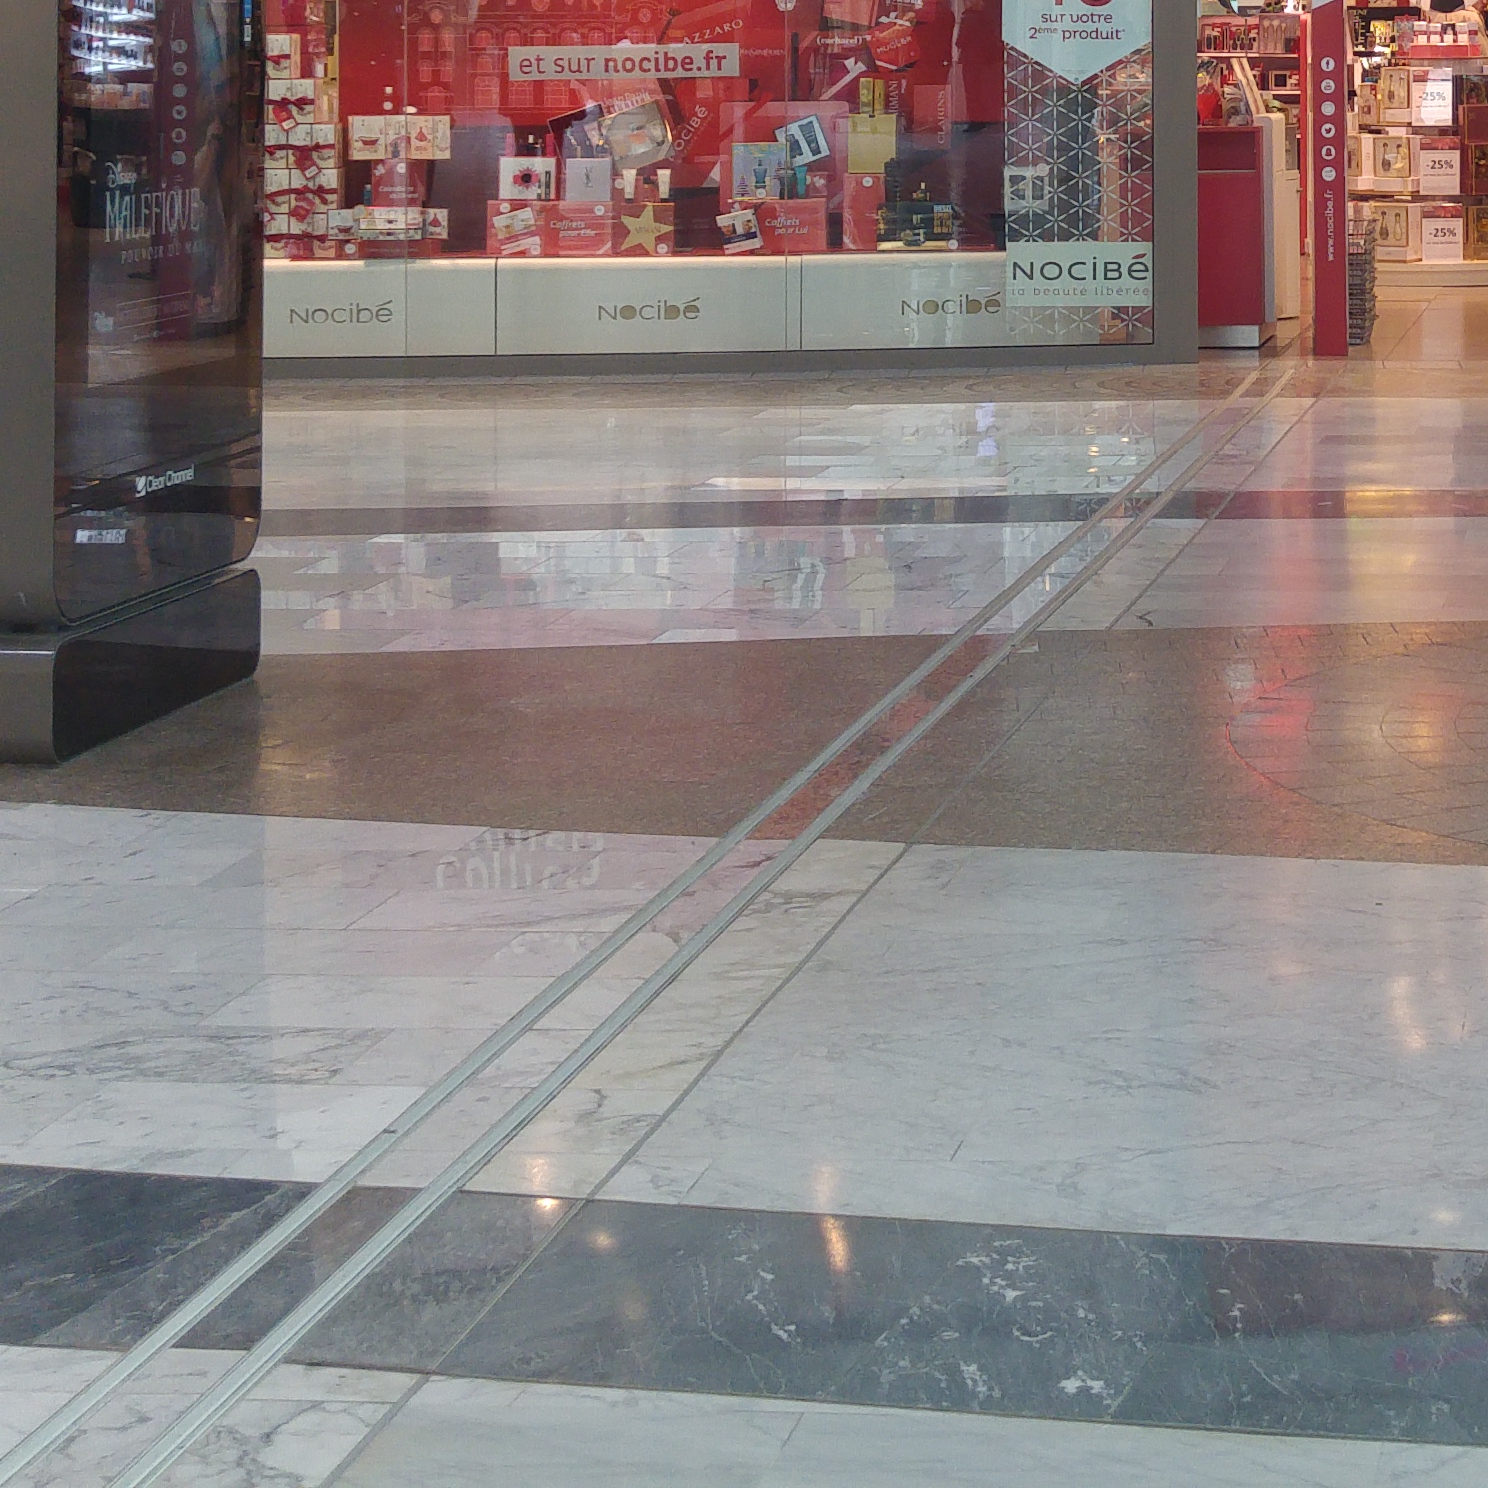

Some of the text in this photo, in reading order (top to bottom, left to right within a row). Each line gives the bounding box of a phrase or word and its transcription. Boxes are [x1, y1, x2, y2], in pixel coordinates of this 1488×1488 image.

[1041, 13, 1066, 23] sur
[682, 19, 743, 44] AZZARO
[876, 35, 912, 54] MUGLER
[519, 55, 546, 74] et
[553, 57, 595, 74] sur
[603, 50, 727, 74] nocibe.fr
[1418, 92, 1447, 101] -25%
[937, 90, 945, 144] CLARINS
[1425, 159, 1454, 170] -25%
[1324, 189, 1335, 261] www.nocibe.fr
[1428, 227, 1457, 238] -25%
[1033, 285, 1088, 296] beauté
[1094, 285, 1150, 296] libérée
